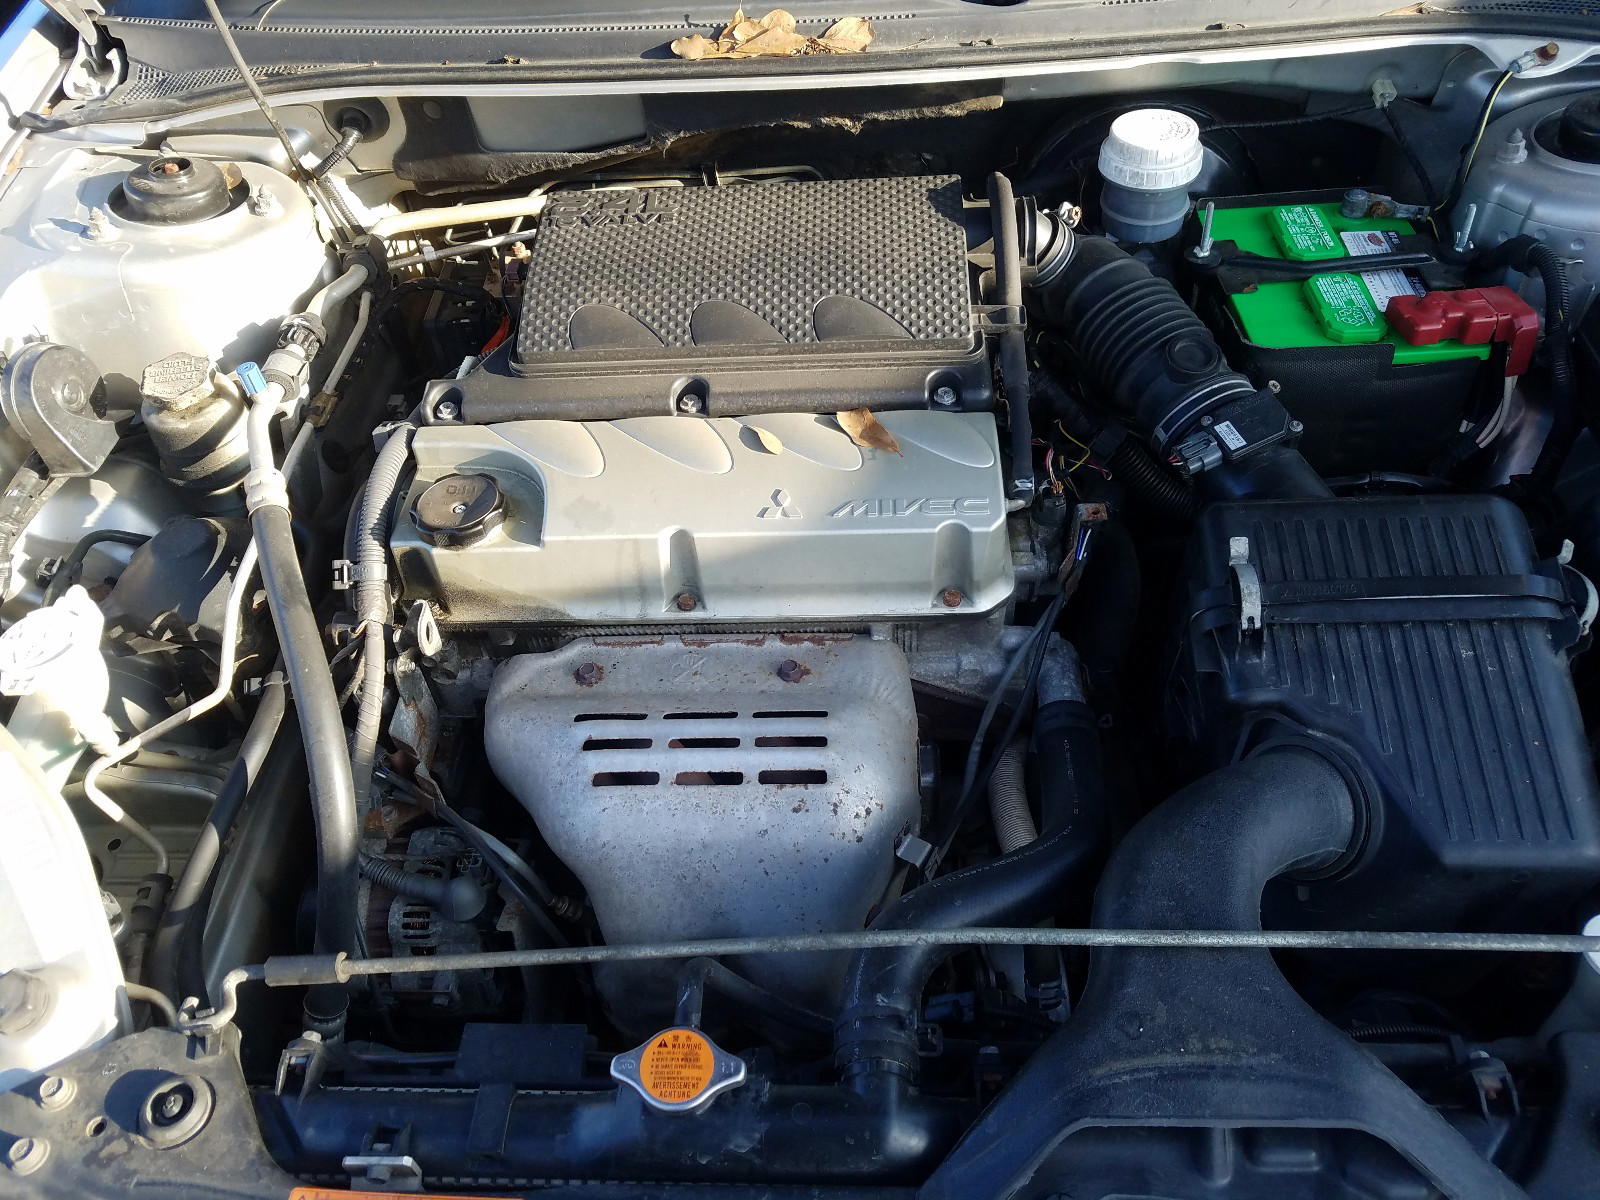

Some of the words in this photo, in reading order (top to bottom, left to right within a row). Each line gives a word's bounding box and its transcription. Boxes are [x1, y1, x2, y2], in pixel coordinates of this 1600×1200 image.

[824, 497, 991, 519] MIVEC
[671, 1043, 702, 1051] WARNING
[651, 1081, 700, 1090] AVERTISSEMENT
[658, 1090, 692, 1099] ACHTUNG
